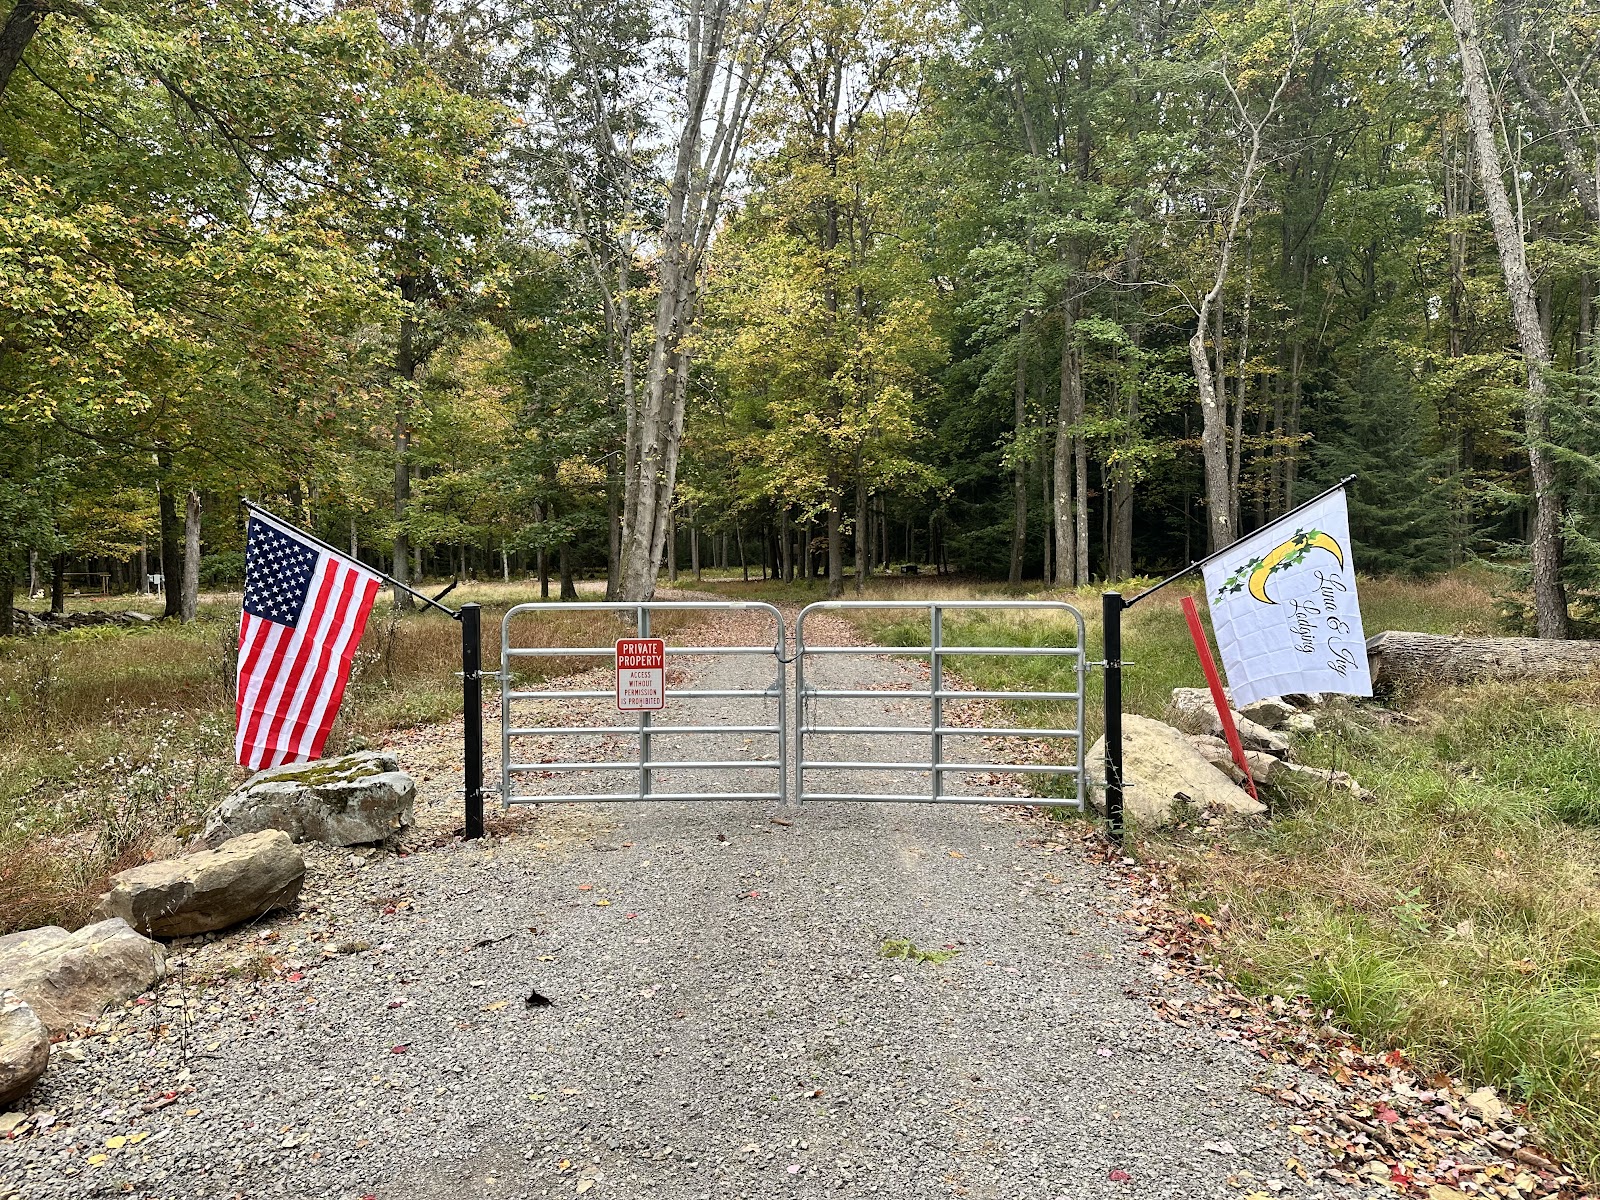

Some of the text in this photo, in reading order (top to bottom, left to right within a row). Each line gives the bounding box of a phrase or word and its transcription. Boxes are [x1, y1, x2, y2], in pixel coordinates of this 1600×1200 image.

[1287, 598, 1321, 655] Lodging
[1312, 570, 1359, 678] Luna & Ivy
[618, 655, 662, 666] PROPERTY
[623, 643, 658, 654] PRIVATE
